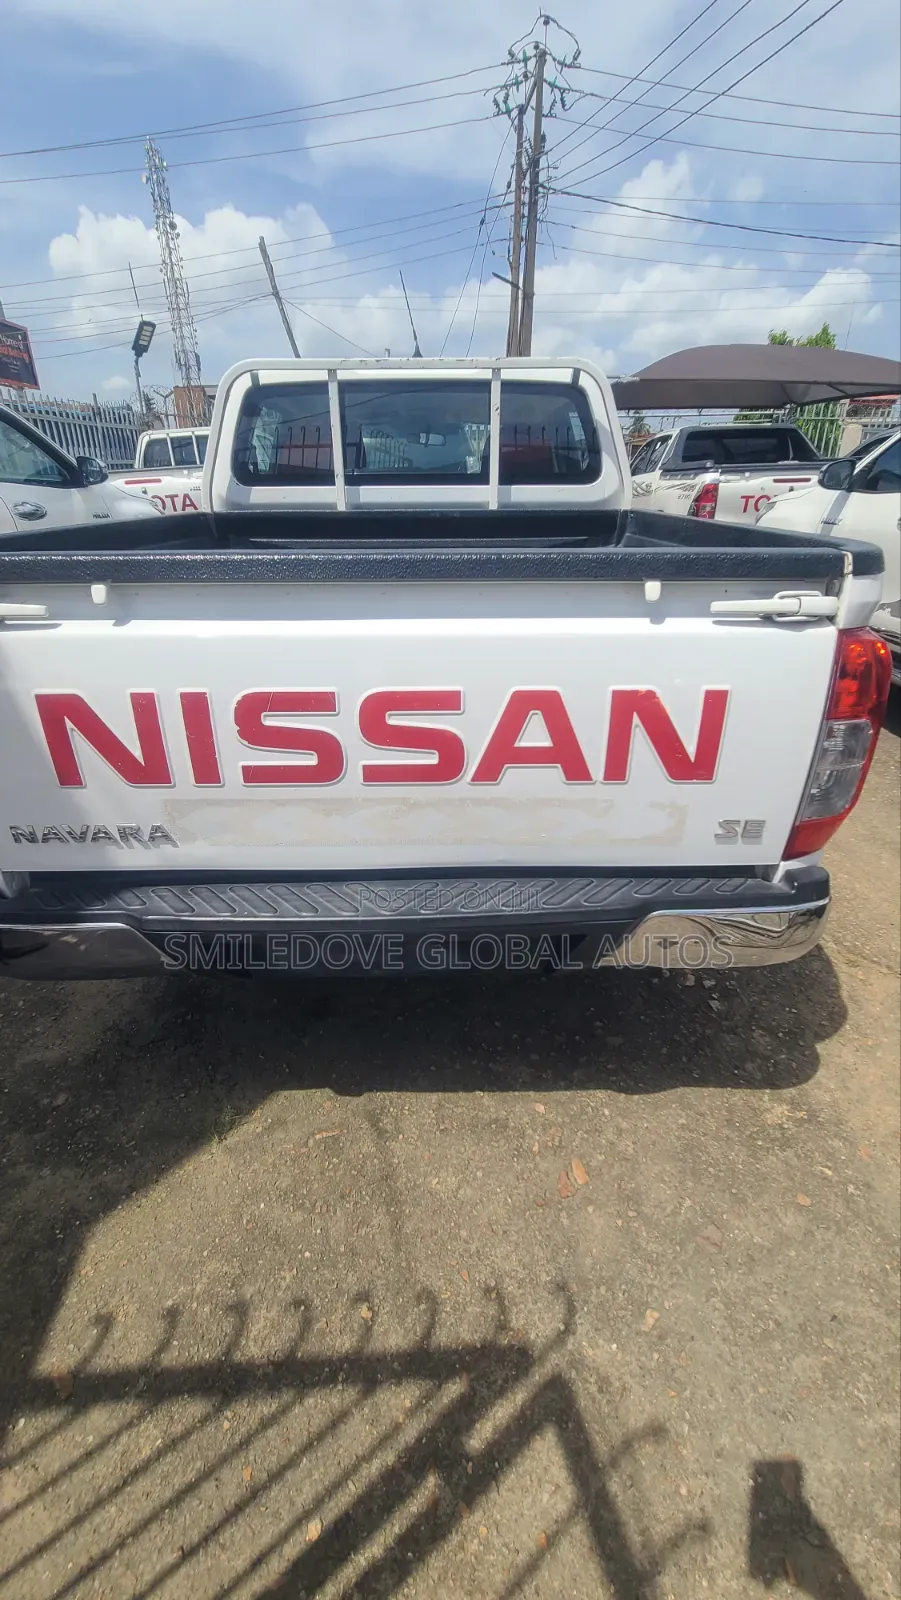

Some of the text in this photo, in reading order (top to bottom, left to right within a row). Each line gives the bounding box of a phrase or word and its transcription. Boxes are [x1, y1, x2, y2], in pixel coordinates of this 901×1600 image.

[32, 686, 731, 788] NISSAN
[9, 823, 180, 848] NAVARA
[713, 819, 766, 843] SE
